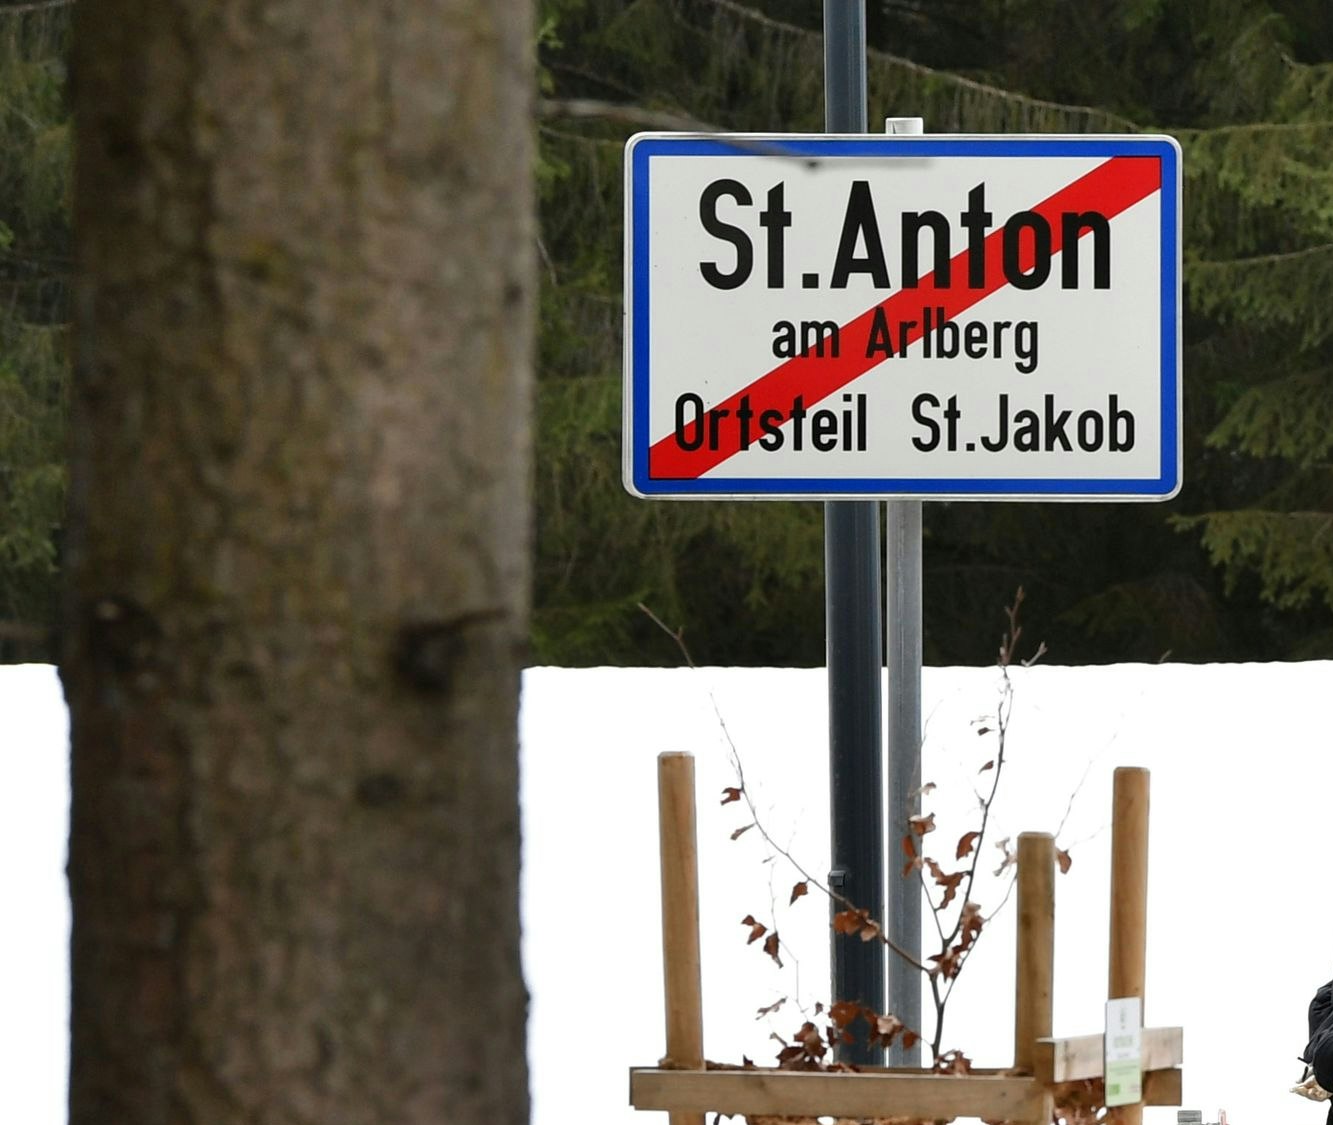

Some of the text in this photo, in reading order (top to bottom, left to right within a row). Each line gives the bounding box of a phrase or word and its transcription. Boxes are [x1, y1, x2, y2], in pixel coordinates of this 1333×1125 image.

[699, 178, 1111, 290] St.Anton
[772, 307, 1039, 373] am Arlberg
[674, 392, 1135, 453] Ortsteil St.Jakob
